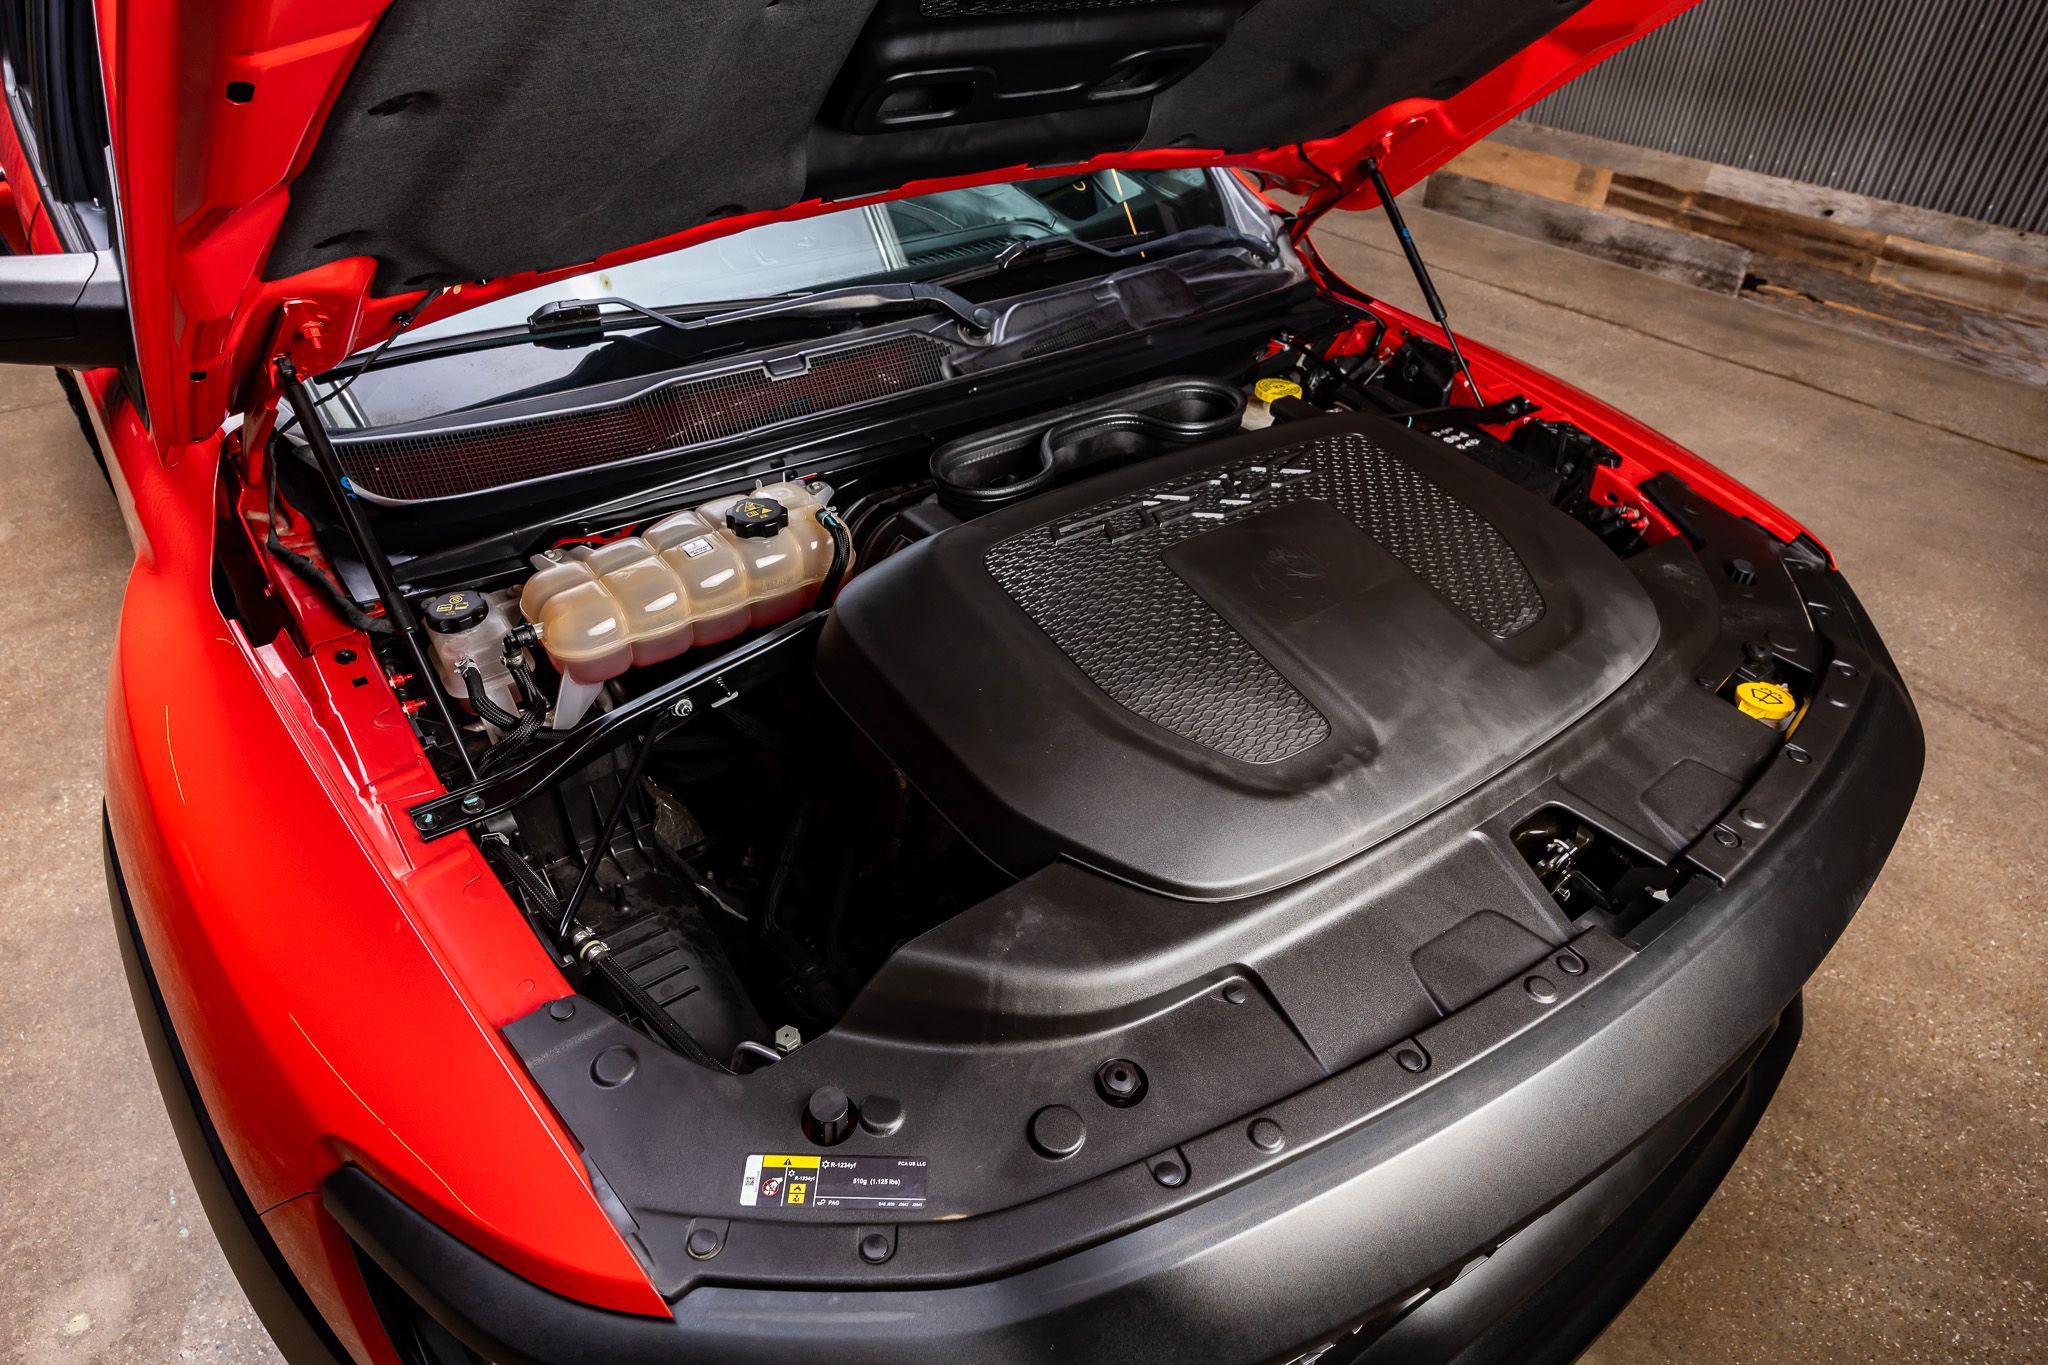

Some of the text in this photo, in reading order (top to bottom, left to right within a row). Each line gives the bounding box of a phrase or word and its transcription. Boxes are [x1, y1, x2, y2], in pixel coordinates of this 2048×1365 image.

[830, 1161, 857, 1170] R-1234yf
[870, 1178, 888, 1186] (1.125
[888, 1178, 901, 1187] lbs)
